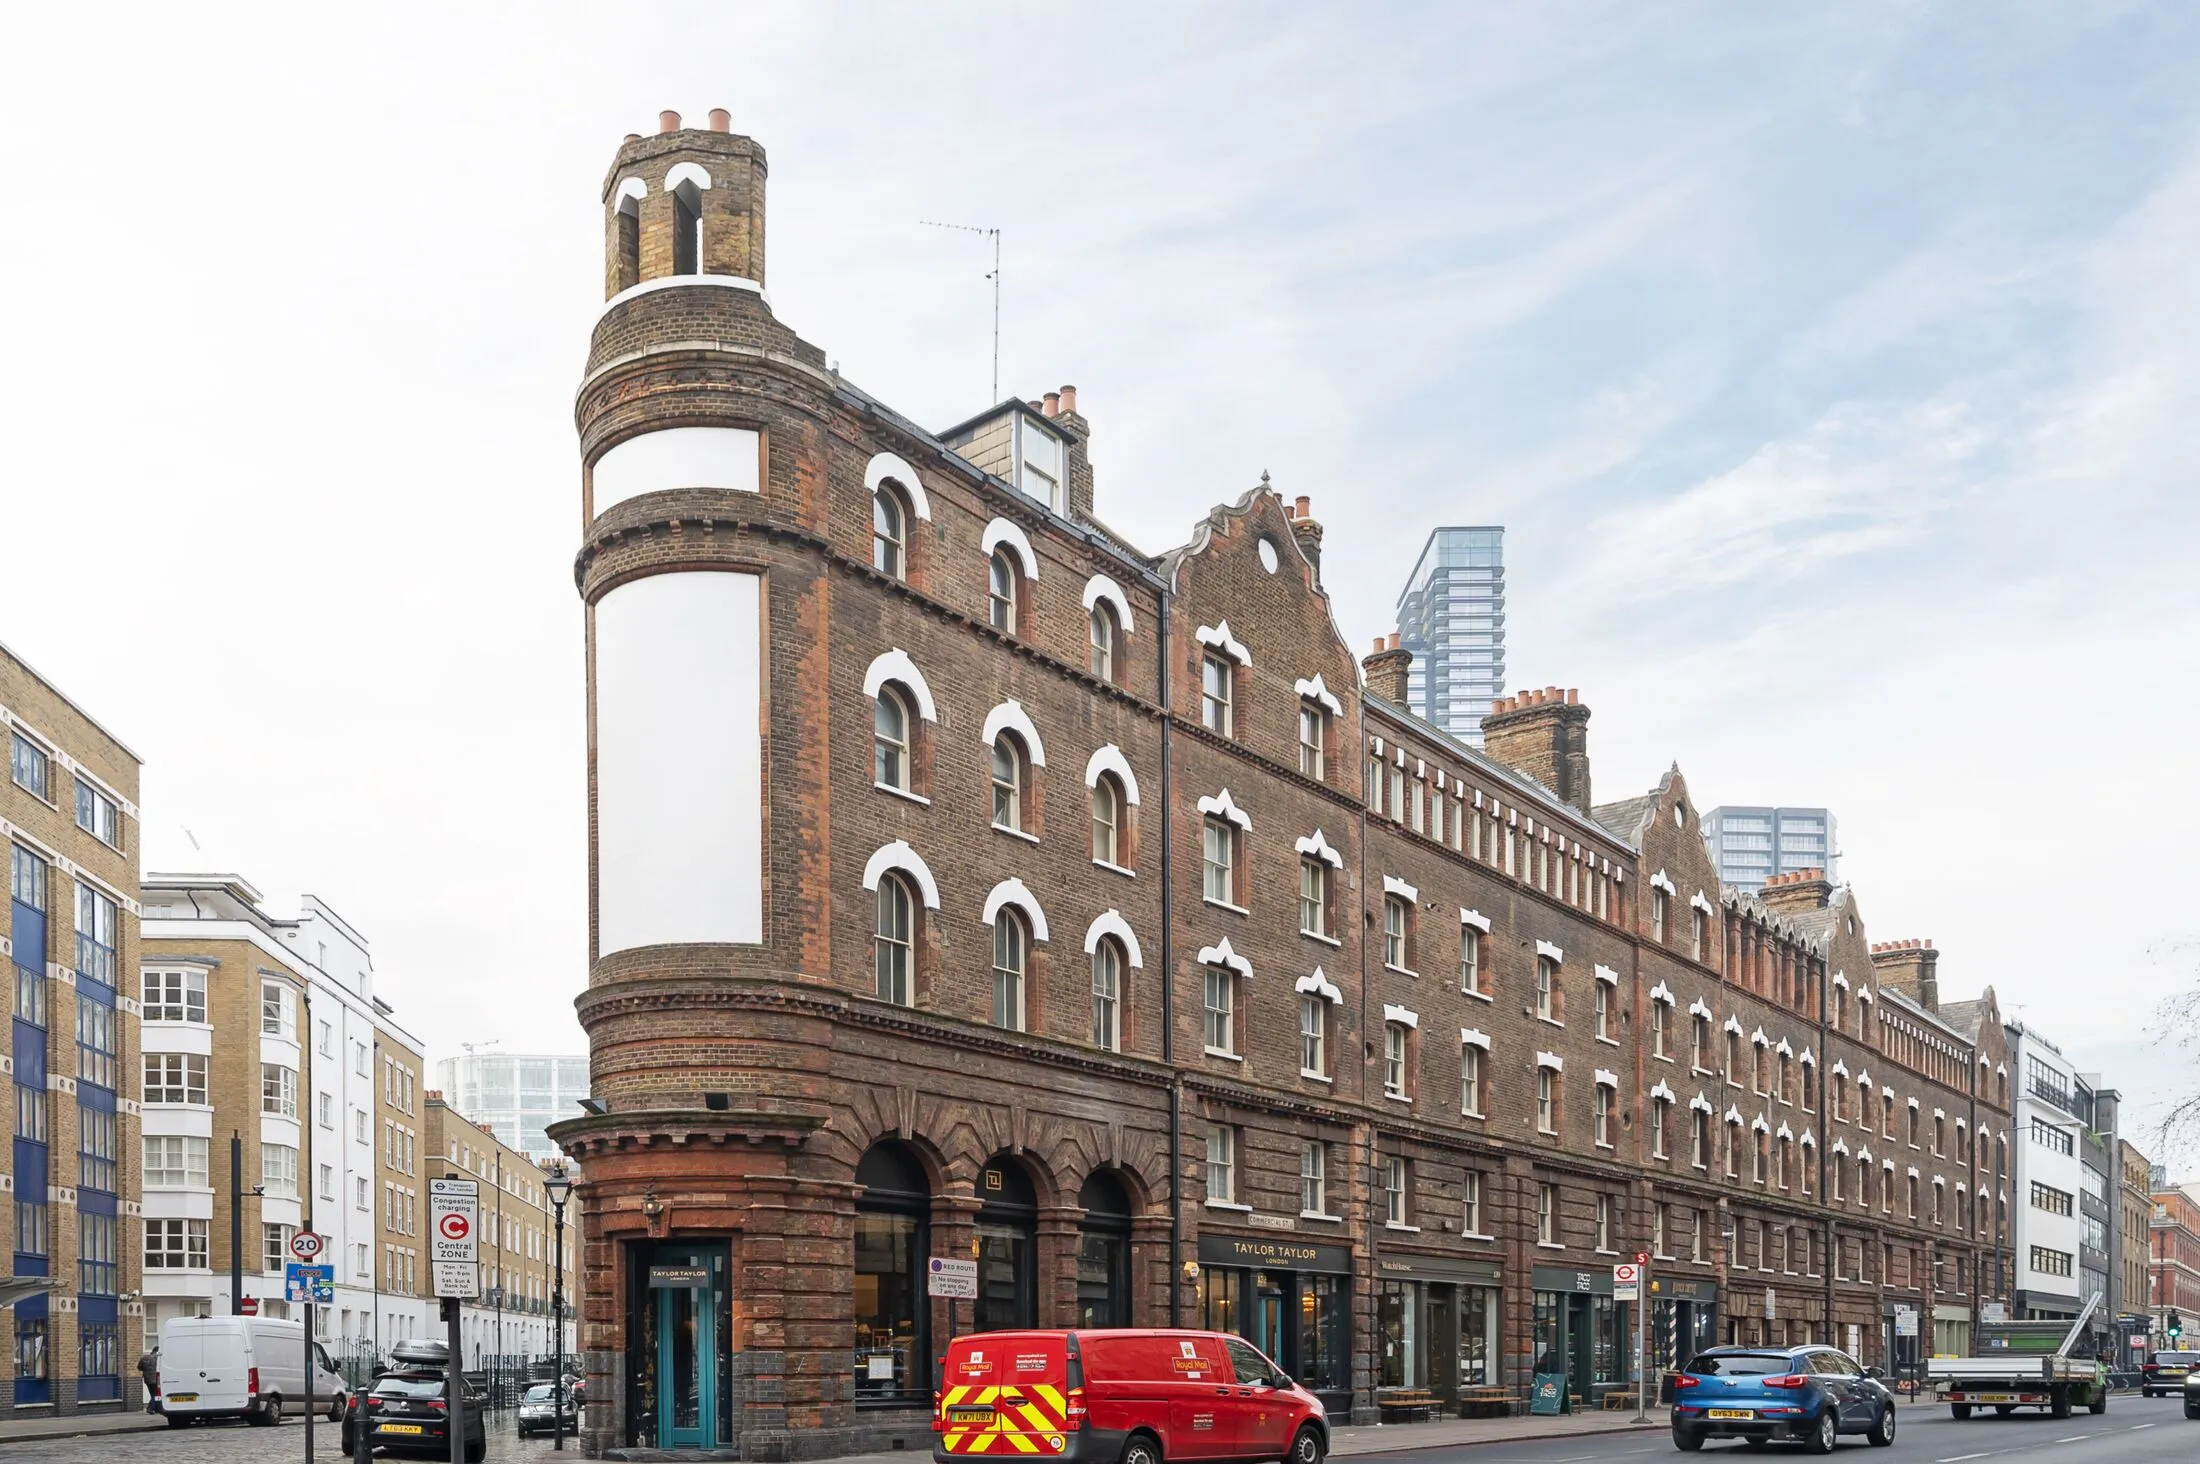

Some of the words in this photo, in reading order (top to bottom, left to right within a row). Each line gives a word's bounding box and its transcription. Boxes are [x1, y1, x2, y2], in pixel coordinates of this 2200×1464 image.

[433, 1197, 476, 1205] Congestion
[438, 1204, 471, 1212] charging
[1249, 1215, 1281, 1227] COMMERCIAL
[295, 1239, 317, 1251] 20
[437, 1241, 472, 1250] Central
[440, 1250, 469, 1258] ZONE
[1234, 1243, 1275, 1256] TAYLOR
[1278, 1246, 1316, 1259] TAYLOR
[1638, 1254, 1645, 1263] S
[947, 1277, 969, 1285] stopping
[1577, 1273, 1591, 1282] TACO
[1576, 1282, 1590, 1290] TACO
[1175, 1361, 1194, 1371] Royal
[1194, 1361, 1208, 1369] Mail
